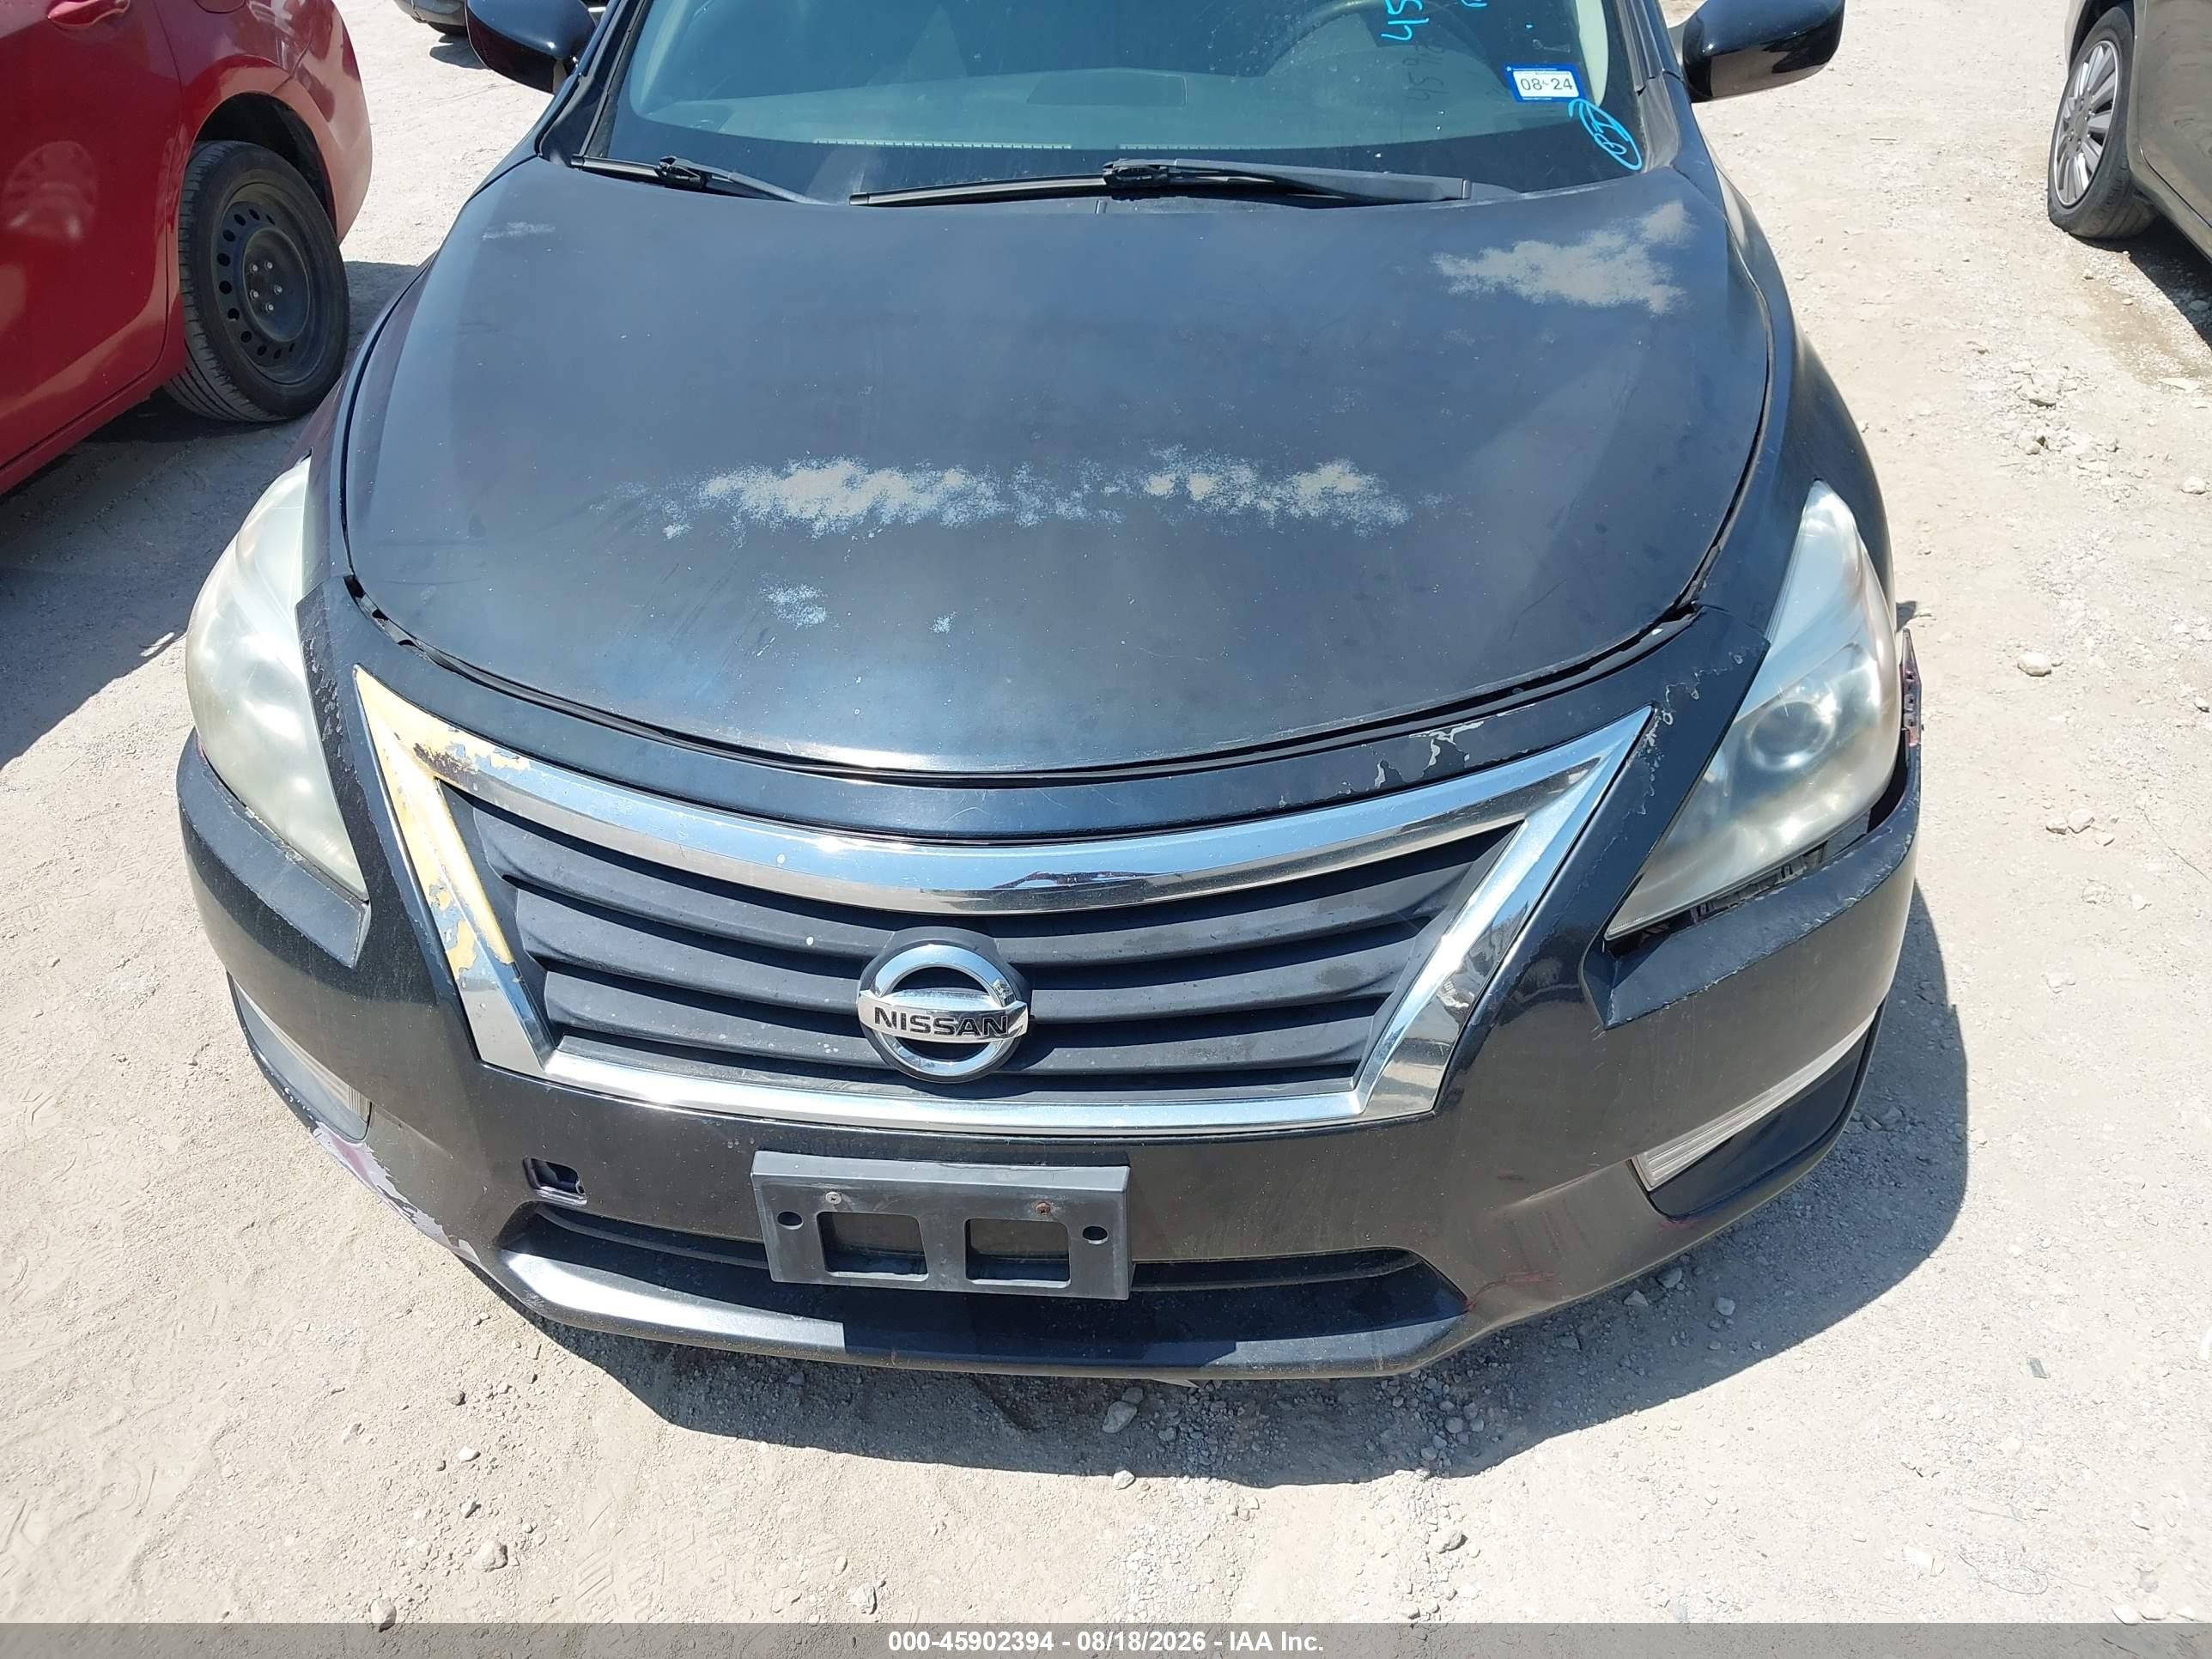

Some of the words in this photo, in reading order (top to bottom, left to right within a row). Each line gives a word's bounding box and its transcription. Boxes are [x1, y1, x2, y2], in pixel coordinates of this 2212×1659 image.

[1520, 78, 1543, 90] 08
[1550, 77, 1573, 90] 24
[874, 1006, 1008, 1036] NISSAN
